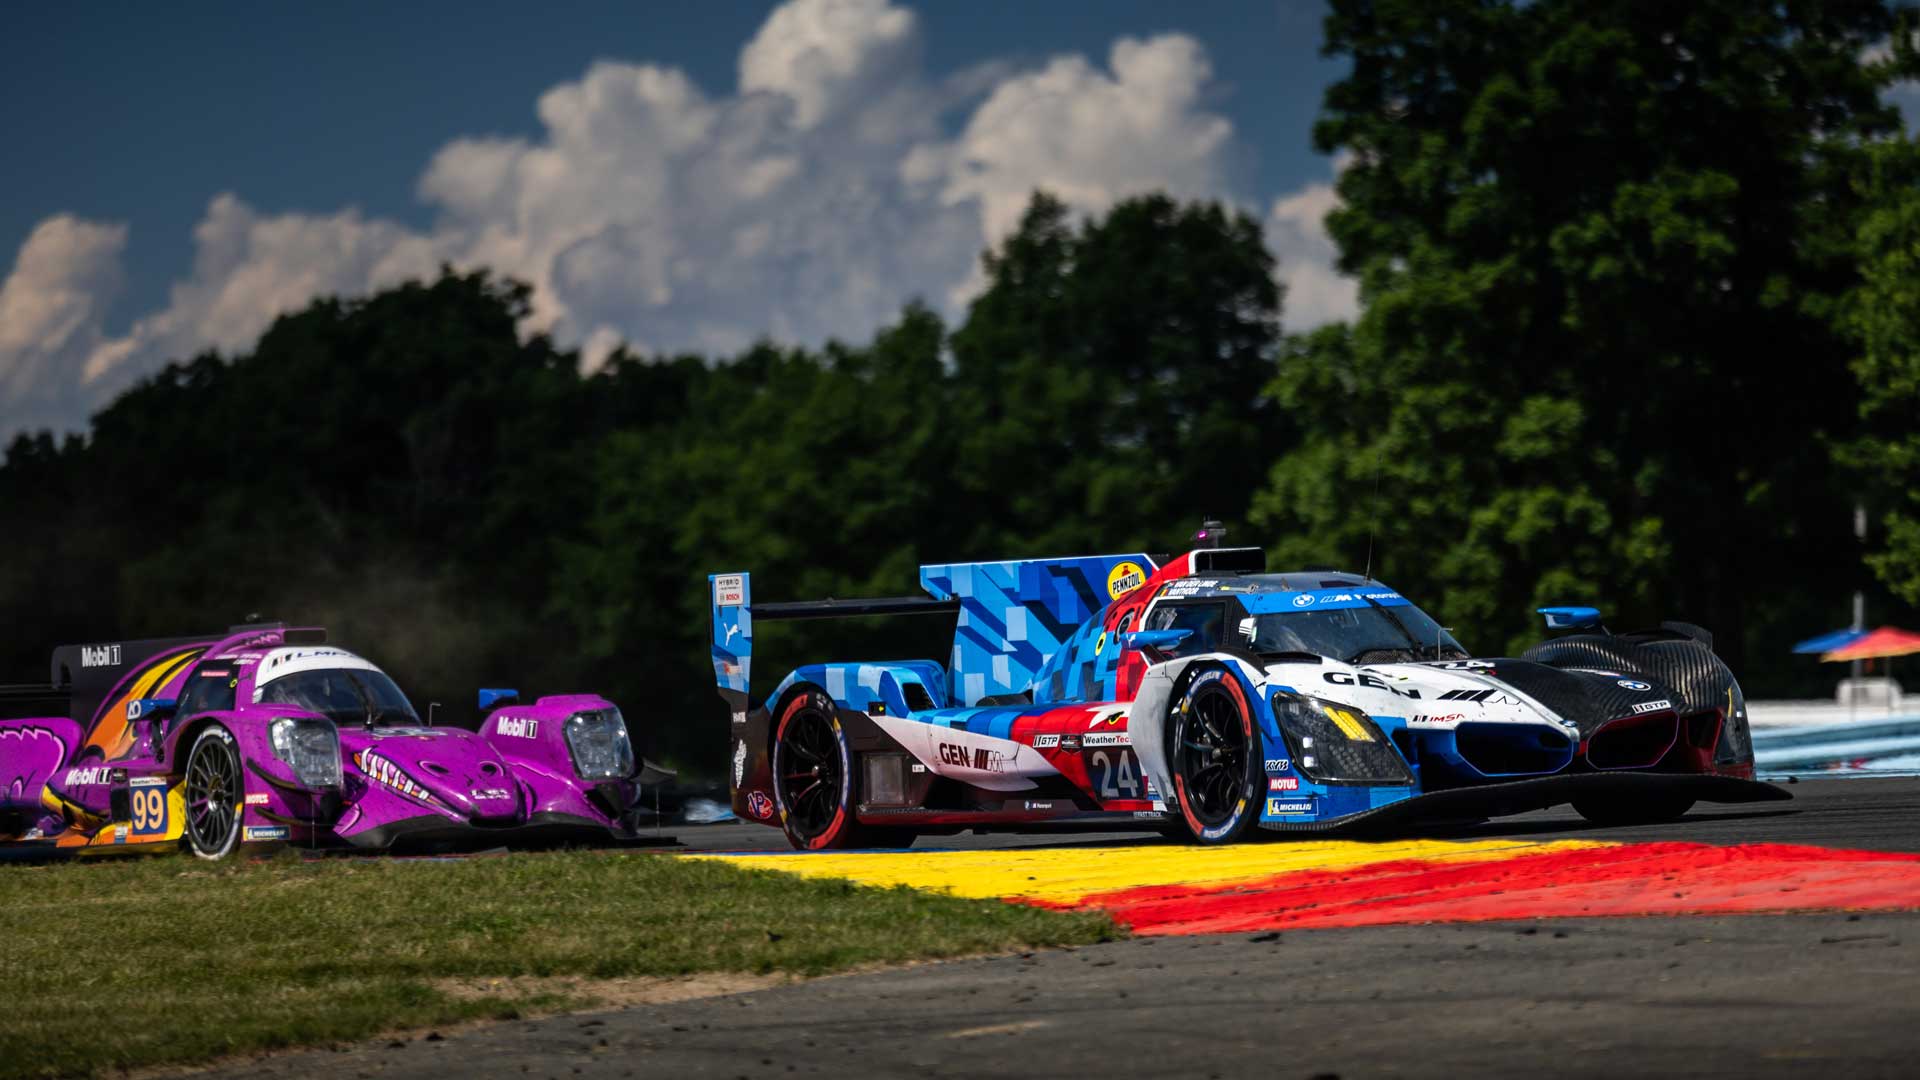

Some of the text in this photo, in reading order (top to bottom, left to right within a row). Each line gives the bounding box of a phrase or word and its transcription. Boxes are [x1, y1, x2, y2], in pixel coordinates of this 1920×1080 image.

[1113, 572, 1141, 594] PENNZOIL
[82, 646, 110, 667] Mobil
[1323, 672, 1422, 699] GEN
[1645, 702, 1667, 710] GTP
[497, 716, 527, 737] Mobil
[1041, 737, 1058, 745] GTP
[1084, 734, 1130, 744] WeatherTec
[939, 743, 970, 768] GEN
[1265, 760, 1288, 770] KYB
[65, 767, 99, 785] Mobil
[1092, 750, 1139, 798] 24
[1270, 779, 1298, 790] MOTUL
[133, 788, 164, 830] 99
